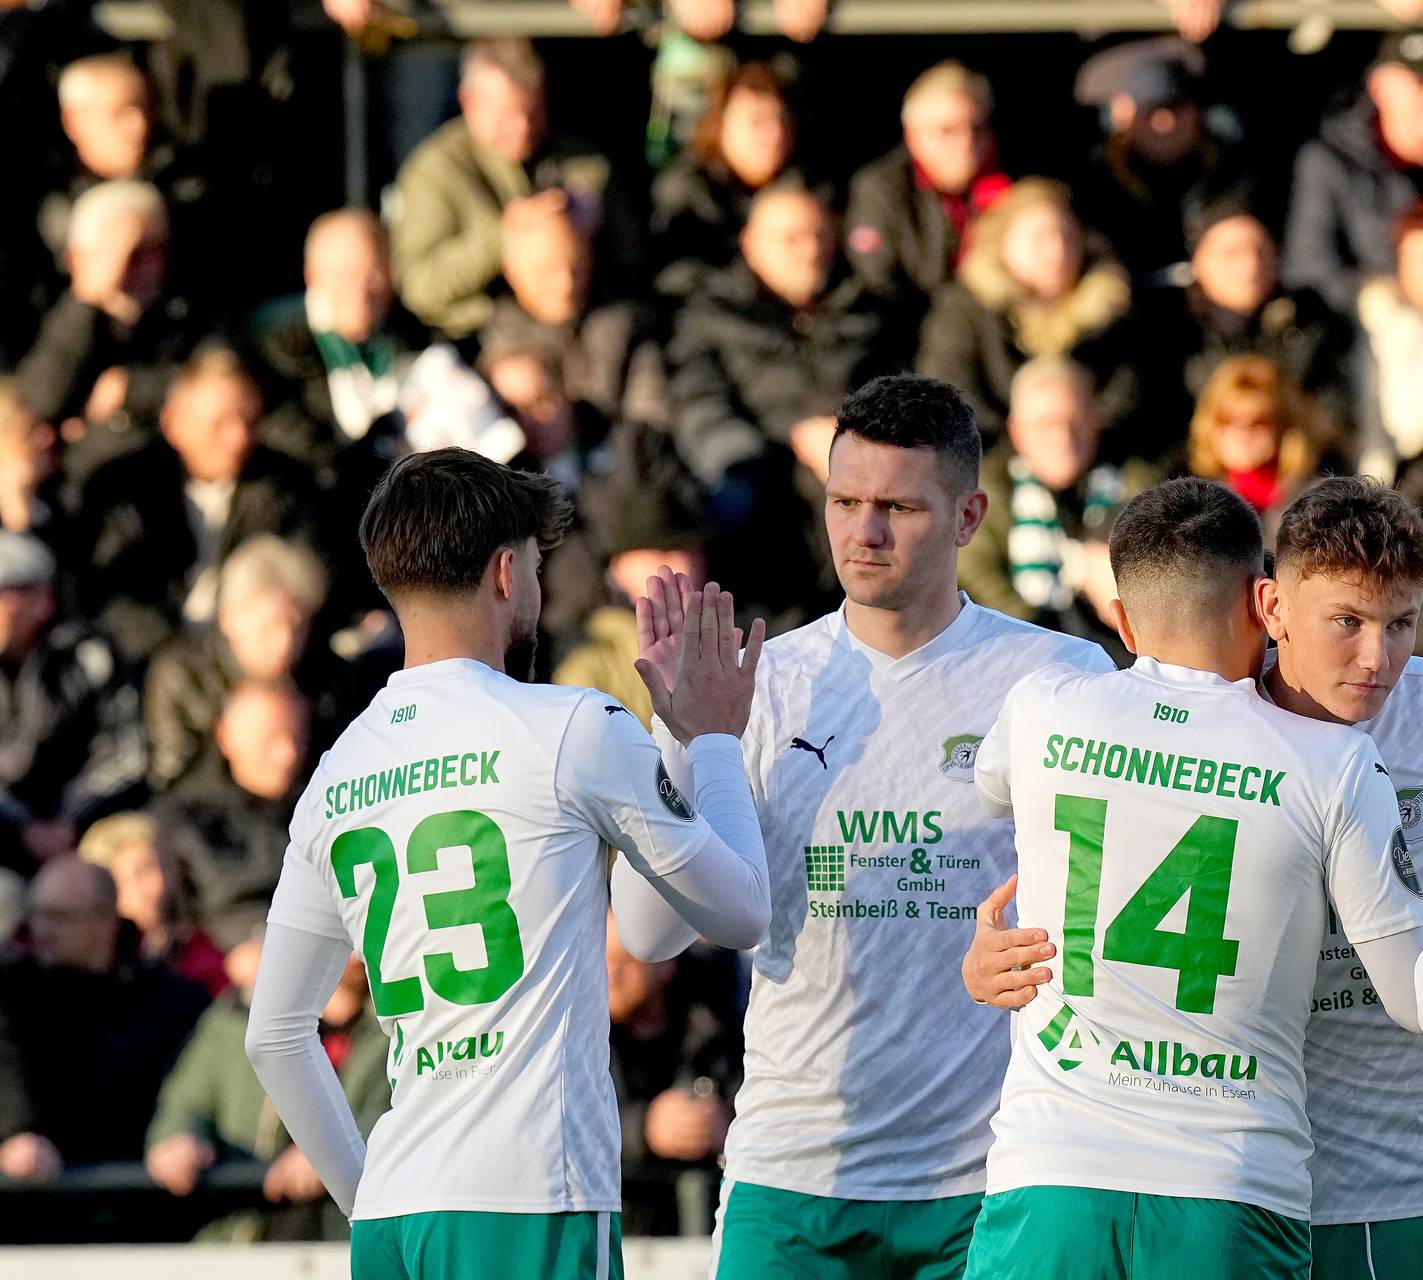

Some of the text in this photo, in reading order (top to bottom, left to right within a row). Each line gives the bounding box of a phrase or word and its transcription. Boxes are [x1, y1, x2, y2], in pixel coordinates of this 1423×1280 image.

[391, 703, 417, 724] 1910
[1152, 702, 1190, 725] 1910
[325, 750, 501, 819] SCHONNEBECK
[1042, 733, 1287, 807] SCHONNEBECK
[836, 810, 944, 845] WMS
[850, 847, 981, 875] Fenster & Türen
[896, 877, 946, 892] GmbH
[330, 809, 525, 1018] 23
[809, 898, 977, 920] Steinbeiß & Team
[1053, 793, 1241, 1016] 14
[1110, 1040, 1258, 1081] Allbau
[1108, 1072, 1256, 1100] Mein Zuhause in Essen
